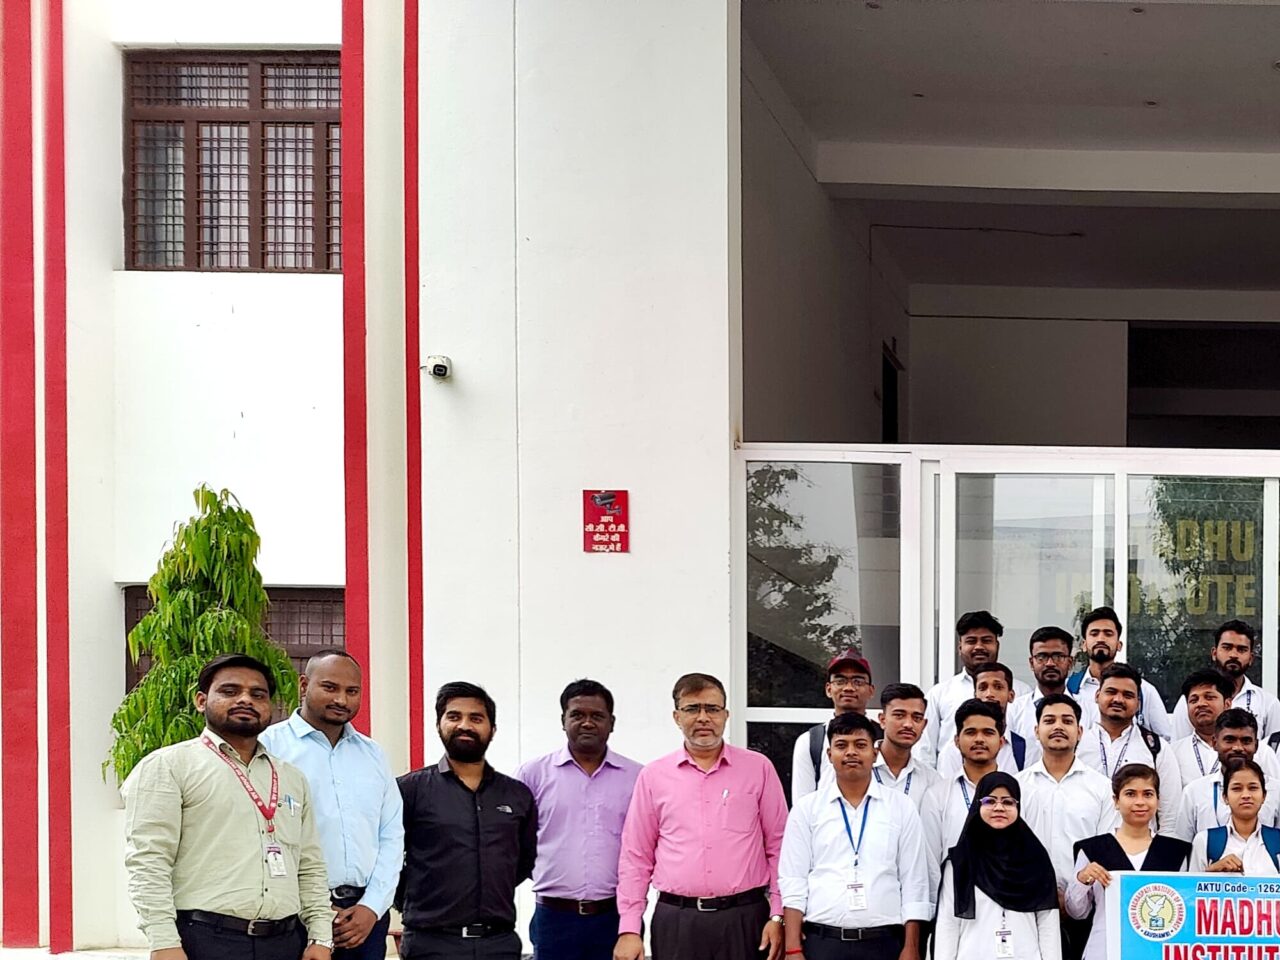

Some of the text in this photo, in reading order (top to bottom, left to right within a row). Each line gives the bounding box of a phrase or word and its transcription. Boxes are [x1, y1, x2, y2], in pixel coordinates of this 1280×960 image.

[1154, 519, 1256, 561] DHU
[1196, 882, 1221, 893] AKTU
[1224, 883, 1248, 893] Code
[1257, 884, 1280, 894] 1262
